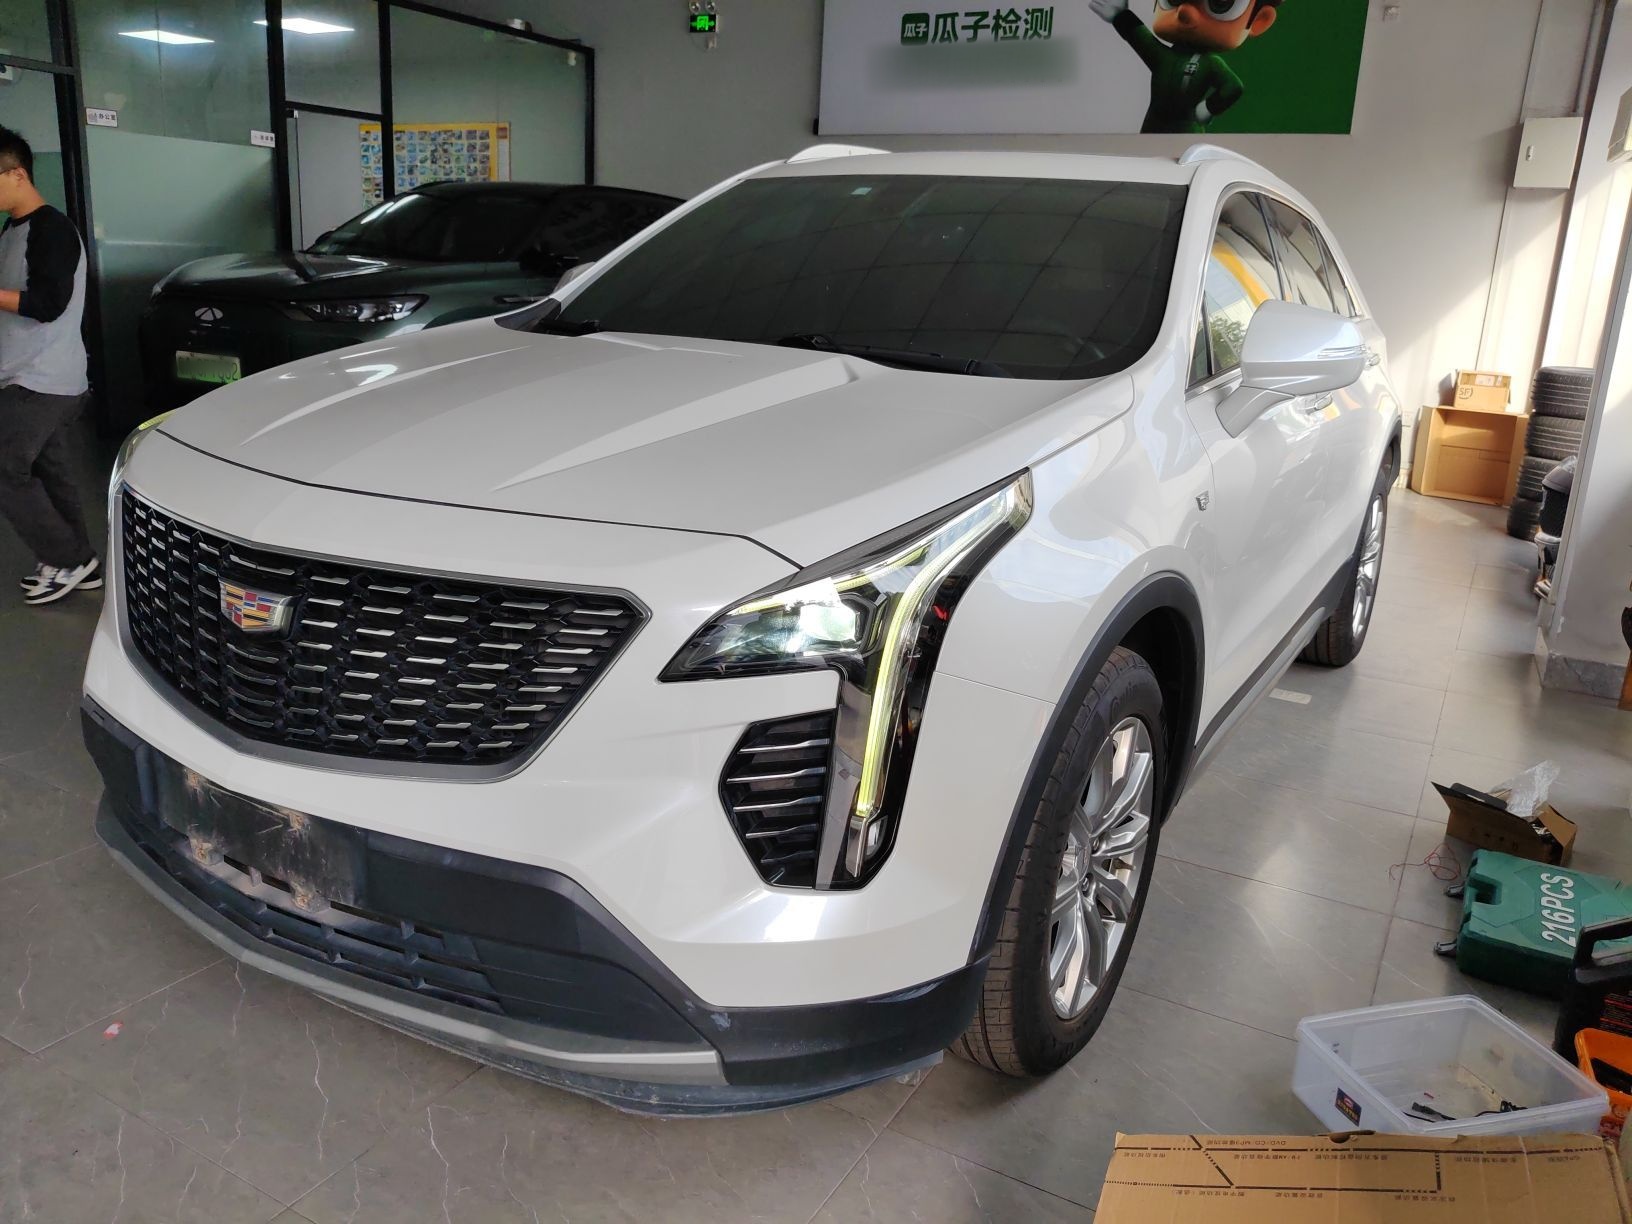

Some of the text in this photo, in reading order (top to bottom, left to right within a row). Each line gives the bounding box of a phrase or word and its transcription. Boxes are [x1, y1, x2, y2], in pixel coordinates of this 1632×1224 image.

[903, 6, 1054, 45] 瓜子 瓜子检测
[1458, 386, 1471, 397] SF
[1540, 872, 1577, 948] 216PCS
